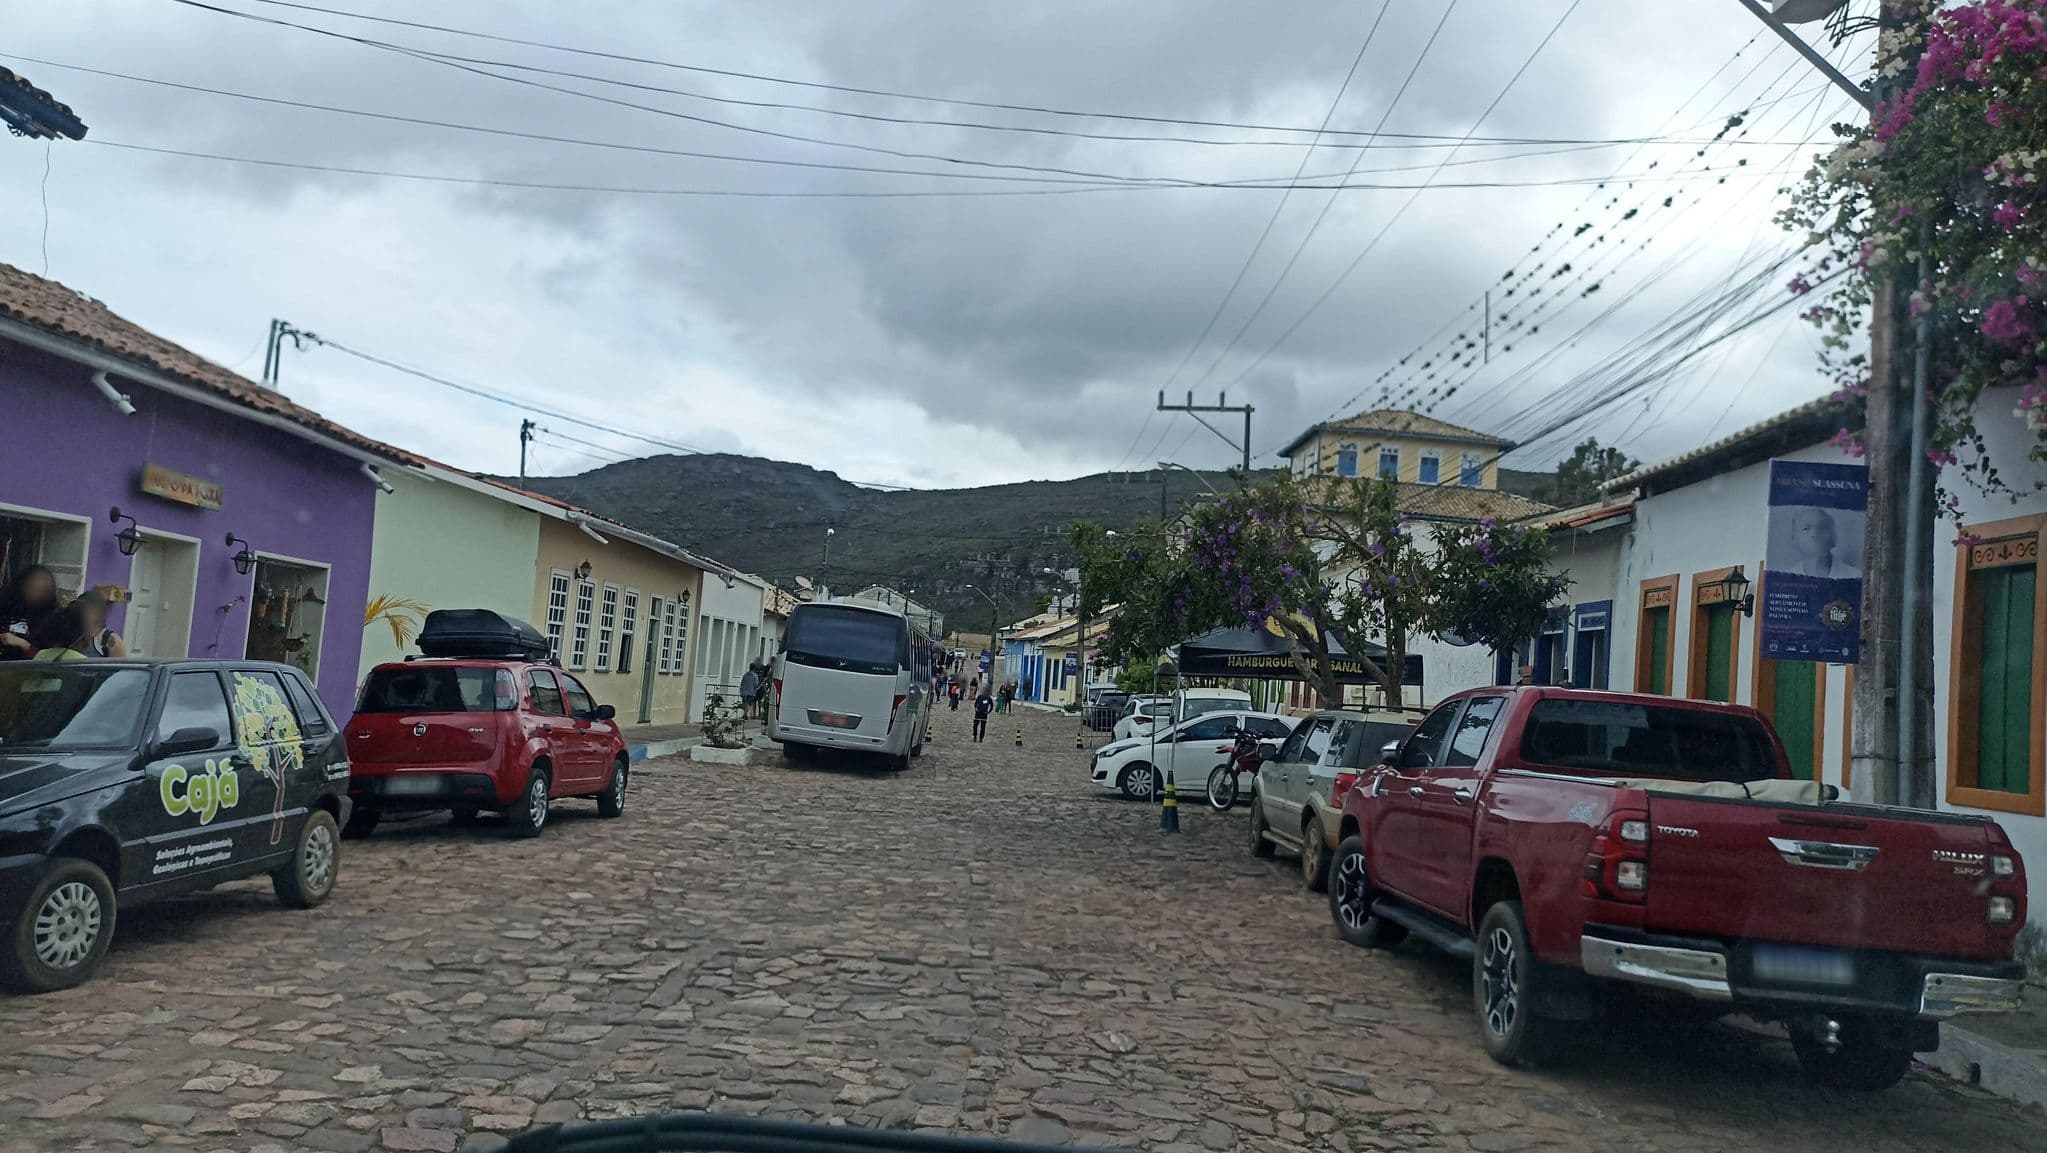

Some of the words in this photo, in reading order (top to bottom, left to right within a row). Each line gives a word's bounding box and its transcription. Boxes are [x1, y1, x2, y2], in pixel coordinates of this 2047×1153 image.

[1228, 655, 1296, 669] HAMBURGUE
[1305, 658, 1363, 673] ARSANAL
[160, 758, 239, 825] Cajá
[1657, 825, 1699, 838] TOYOTA
[1932, 850, 1985, 864] HILUX
